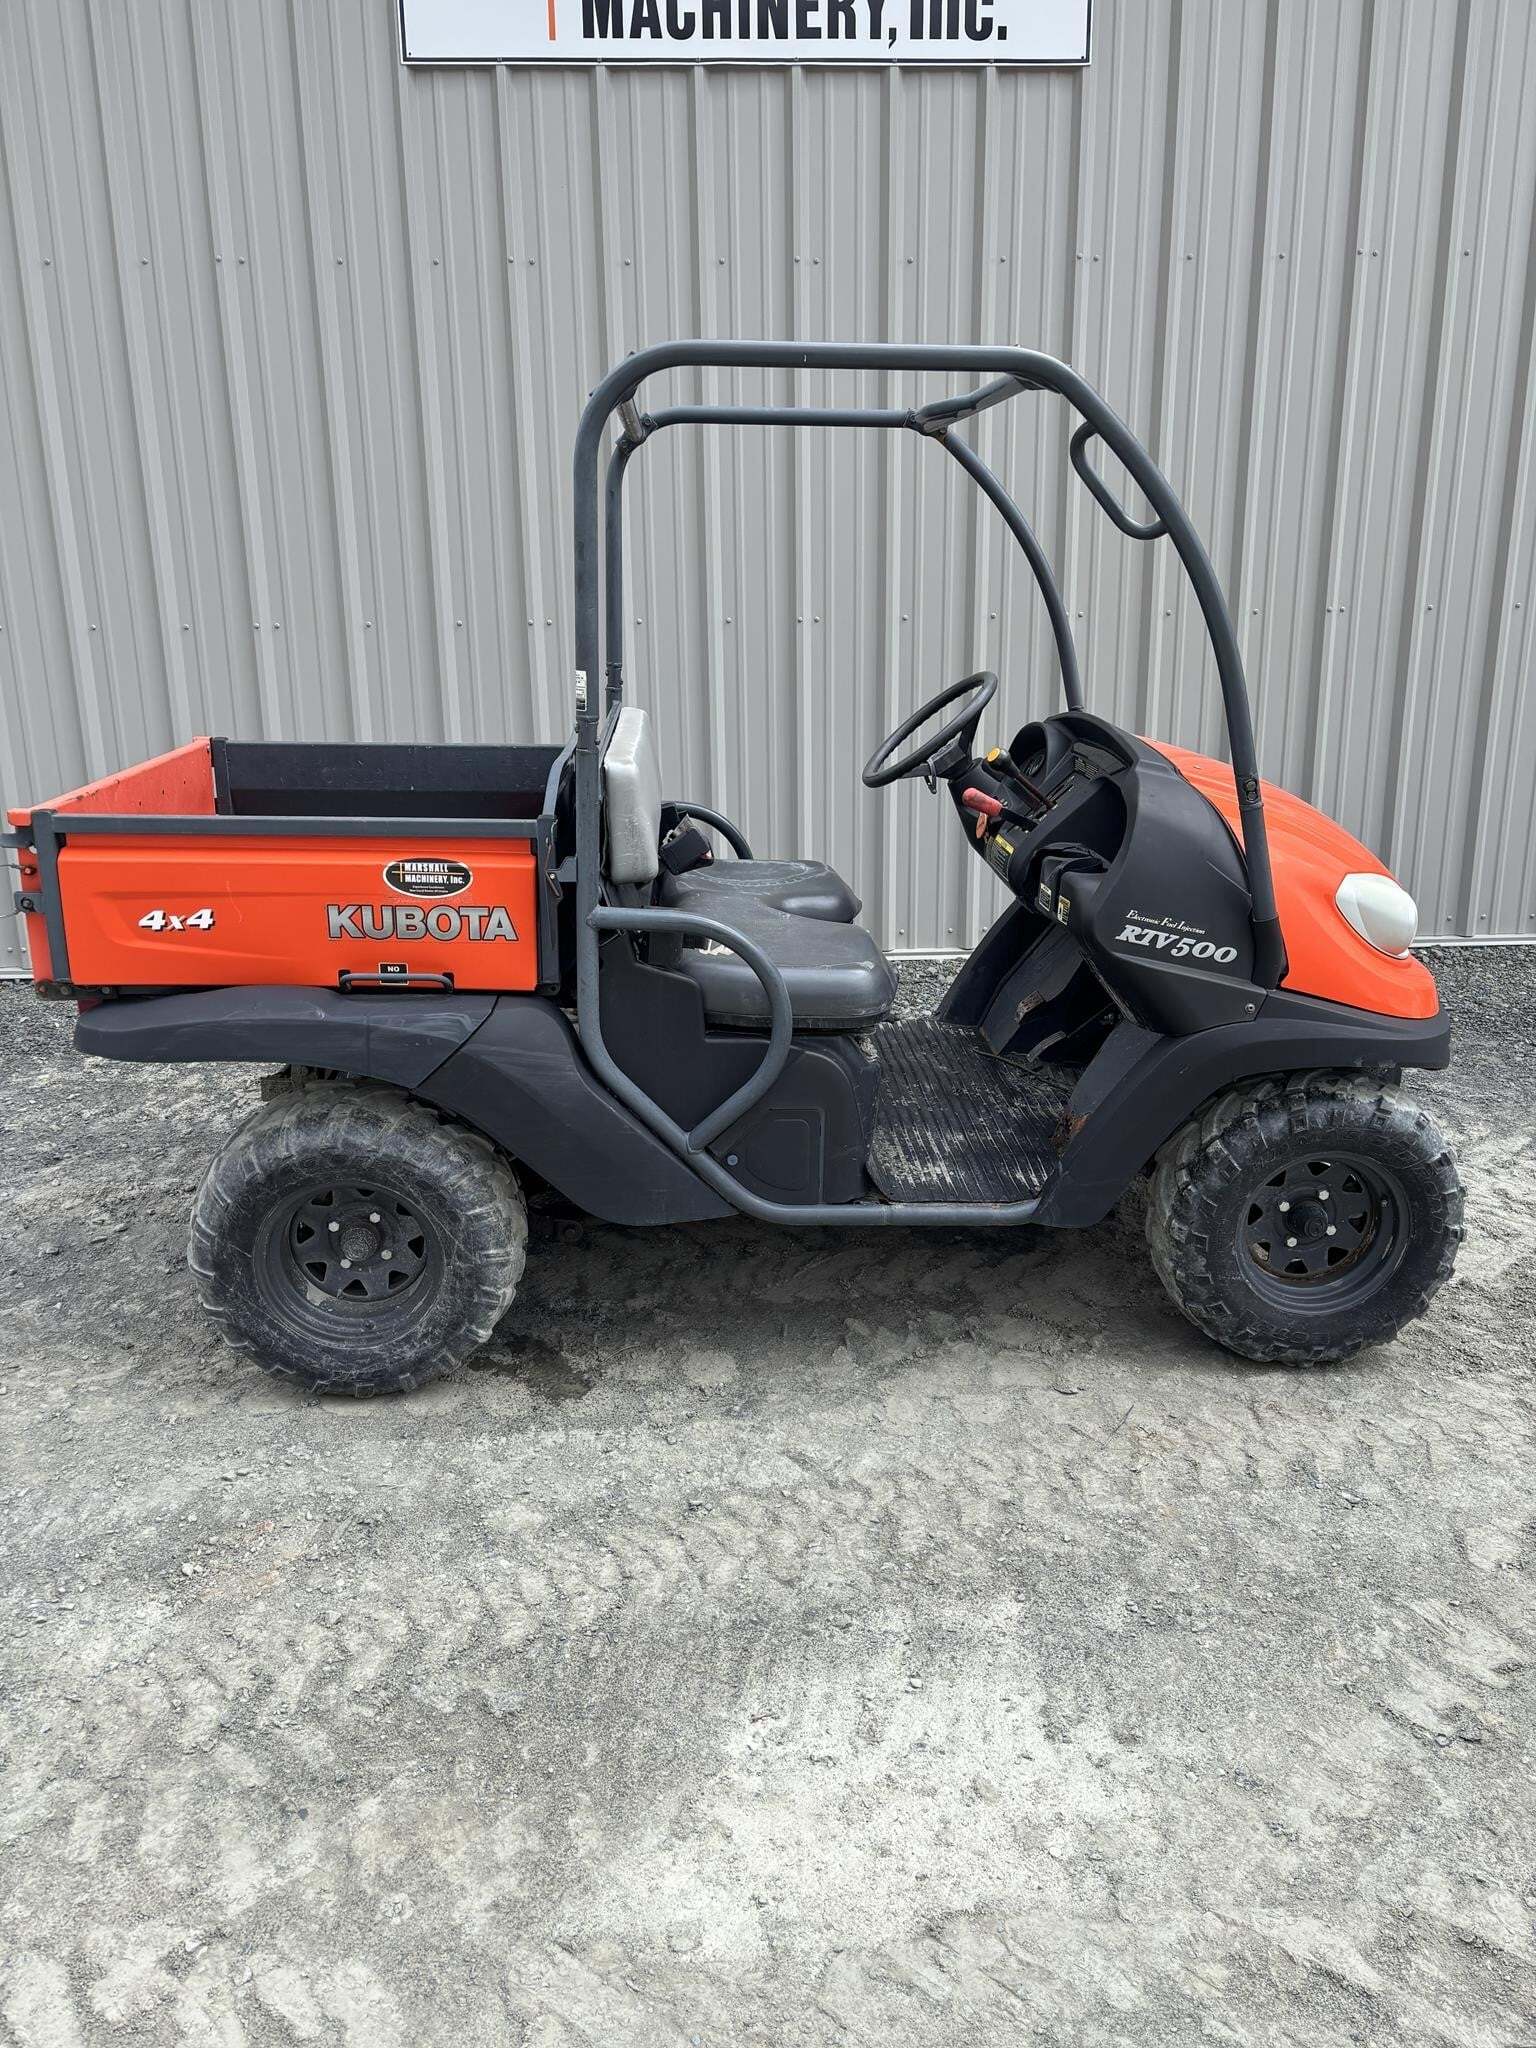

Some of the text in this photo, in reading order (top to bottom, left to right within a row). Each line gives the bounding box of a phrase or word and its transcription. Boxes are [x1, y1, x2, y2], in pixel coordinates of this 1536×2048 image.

[582, 0, 897, 49] MACHINERY,
[404, 863, 449, 873] MARSHALL
[404, 874, 465, 885] MACHINERY, Inc.
[138, 908, 216, 932] 4x4
[327, 904, 519, 941] KUBOTA
[1126, 909, 1206, 935] Electronic Fuel Injection
[1114, 924, 1238, 963] RTV500
[387, 965, 400, 973] NO
